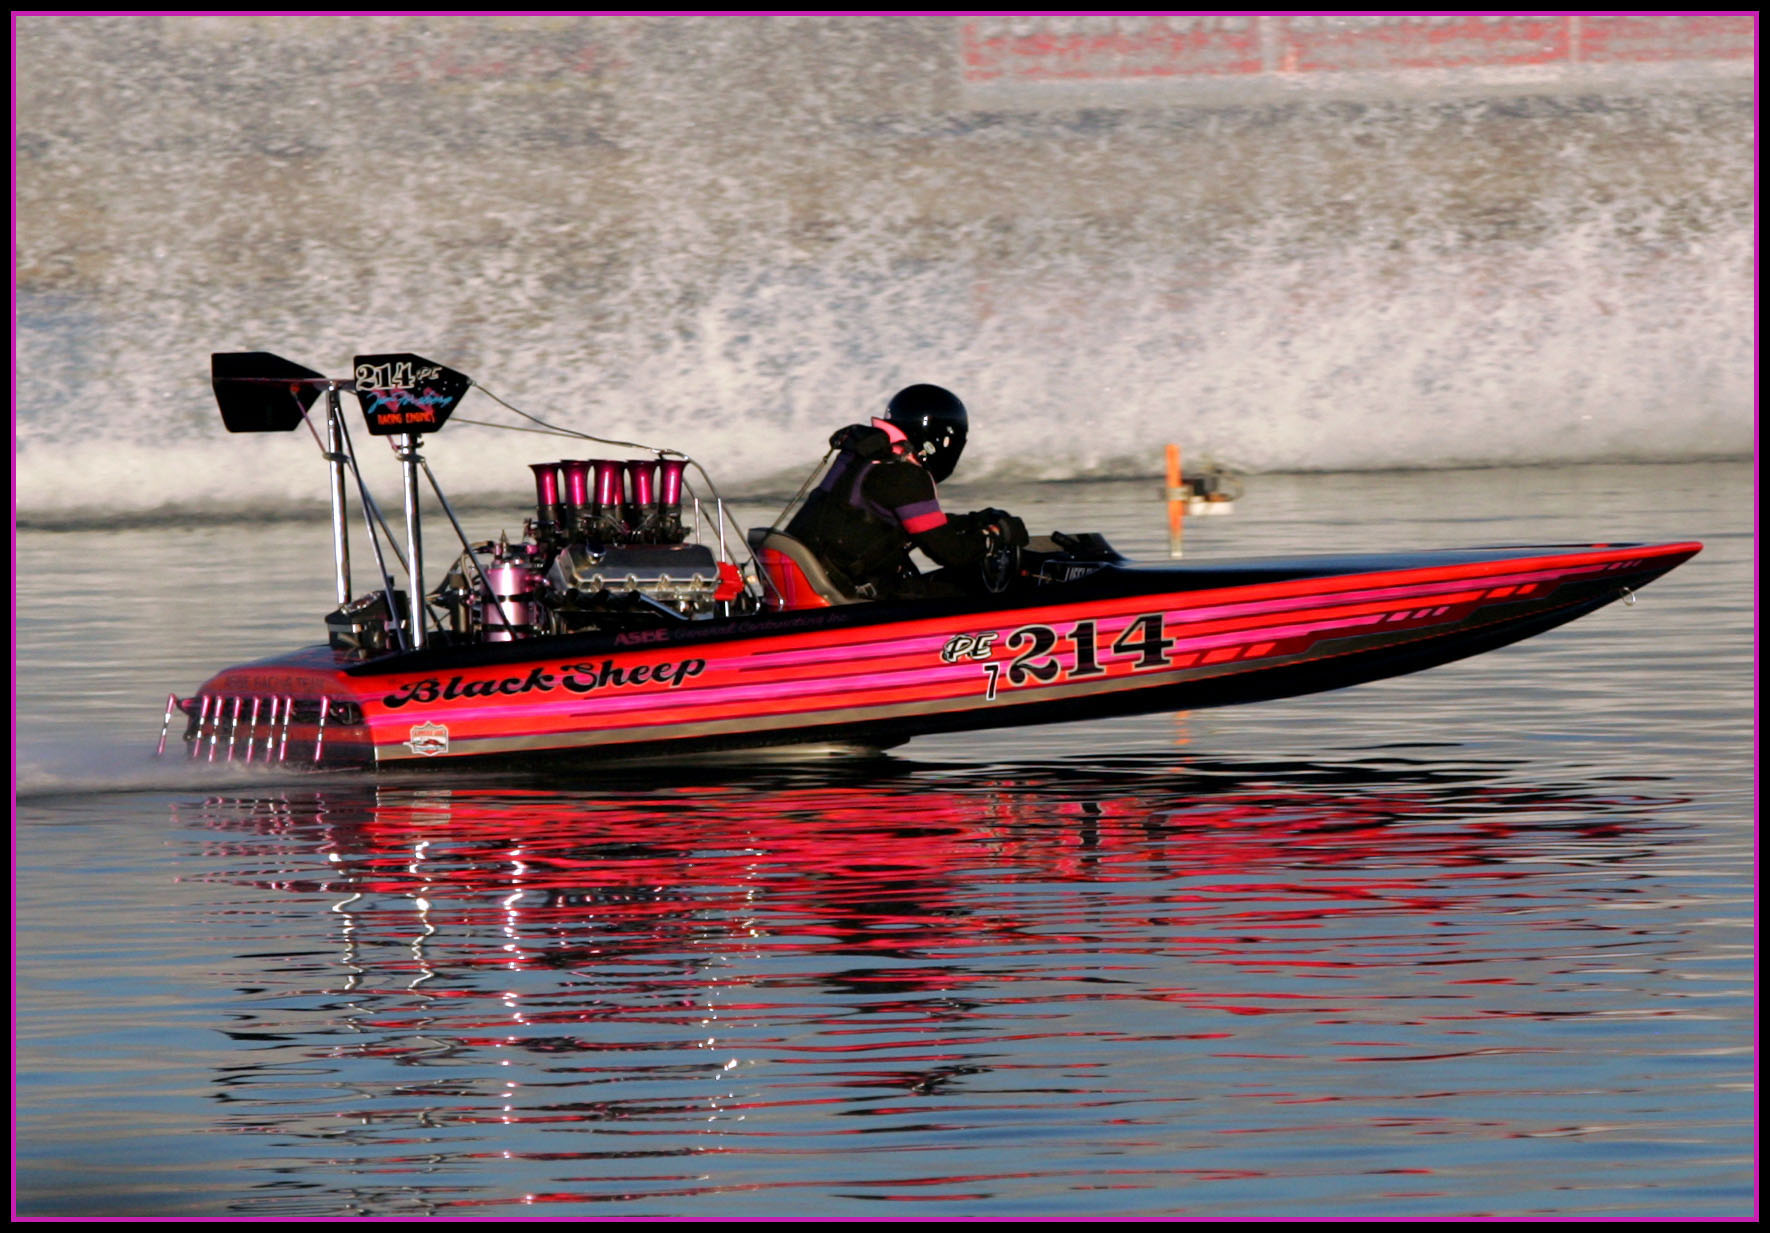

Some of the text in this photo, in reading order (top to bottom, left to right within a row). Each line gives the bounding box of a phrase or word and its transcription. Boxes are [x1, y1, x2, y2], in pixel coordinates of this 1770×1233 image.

[355, 362, 416, 391] 214
[939, 631, 999, 664] PE
[1005, 611, 1177, 687] 214
[383, 659, 706, 708] Black Sheep
[983, 662, 1000, 700] 7
